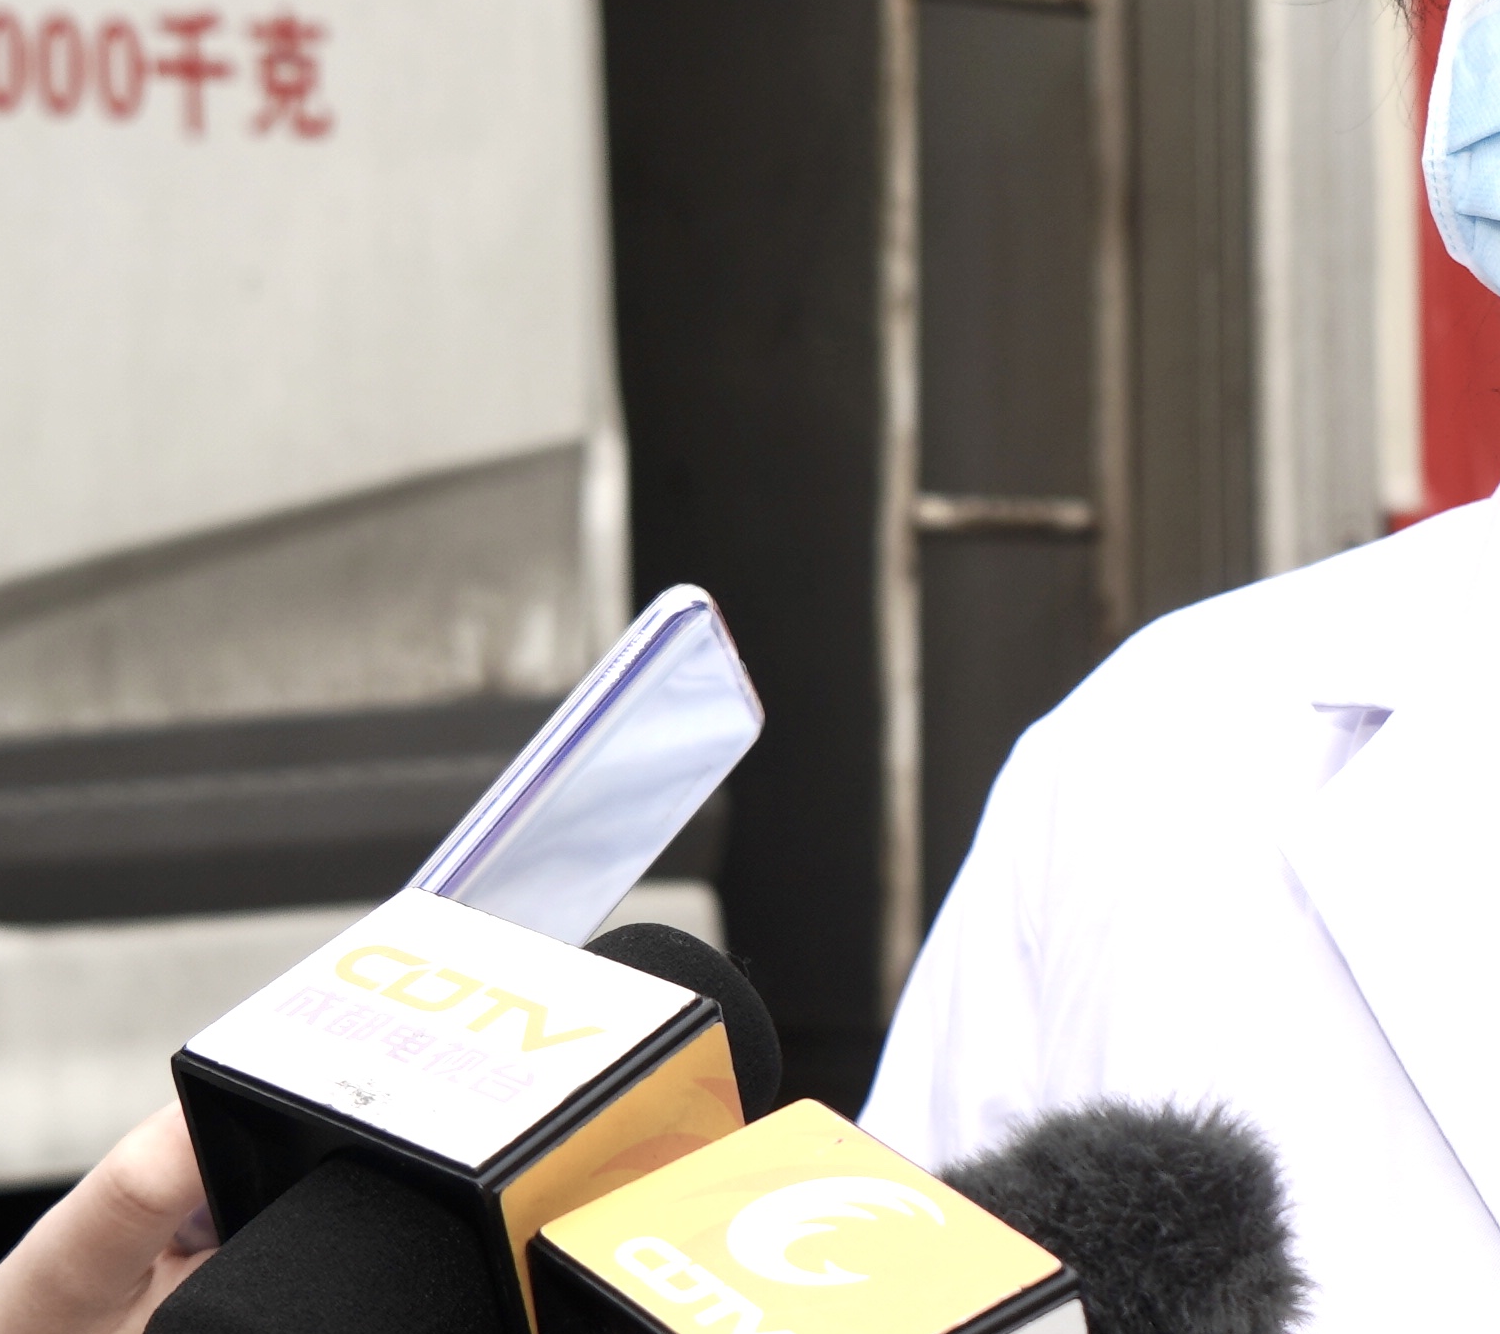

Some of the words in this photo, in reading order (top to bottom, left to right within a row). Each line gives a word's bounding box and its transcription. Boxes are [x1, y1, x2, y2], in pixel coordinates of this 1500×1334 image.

[273, 985, 536, 1104] 成都电视台
[334, 944, 607, 1053] CDTV
